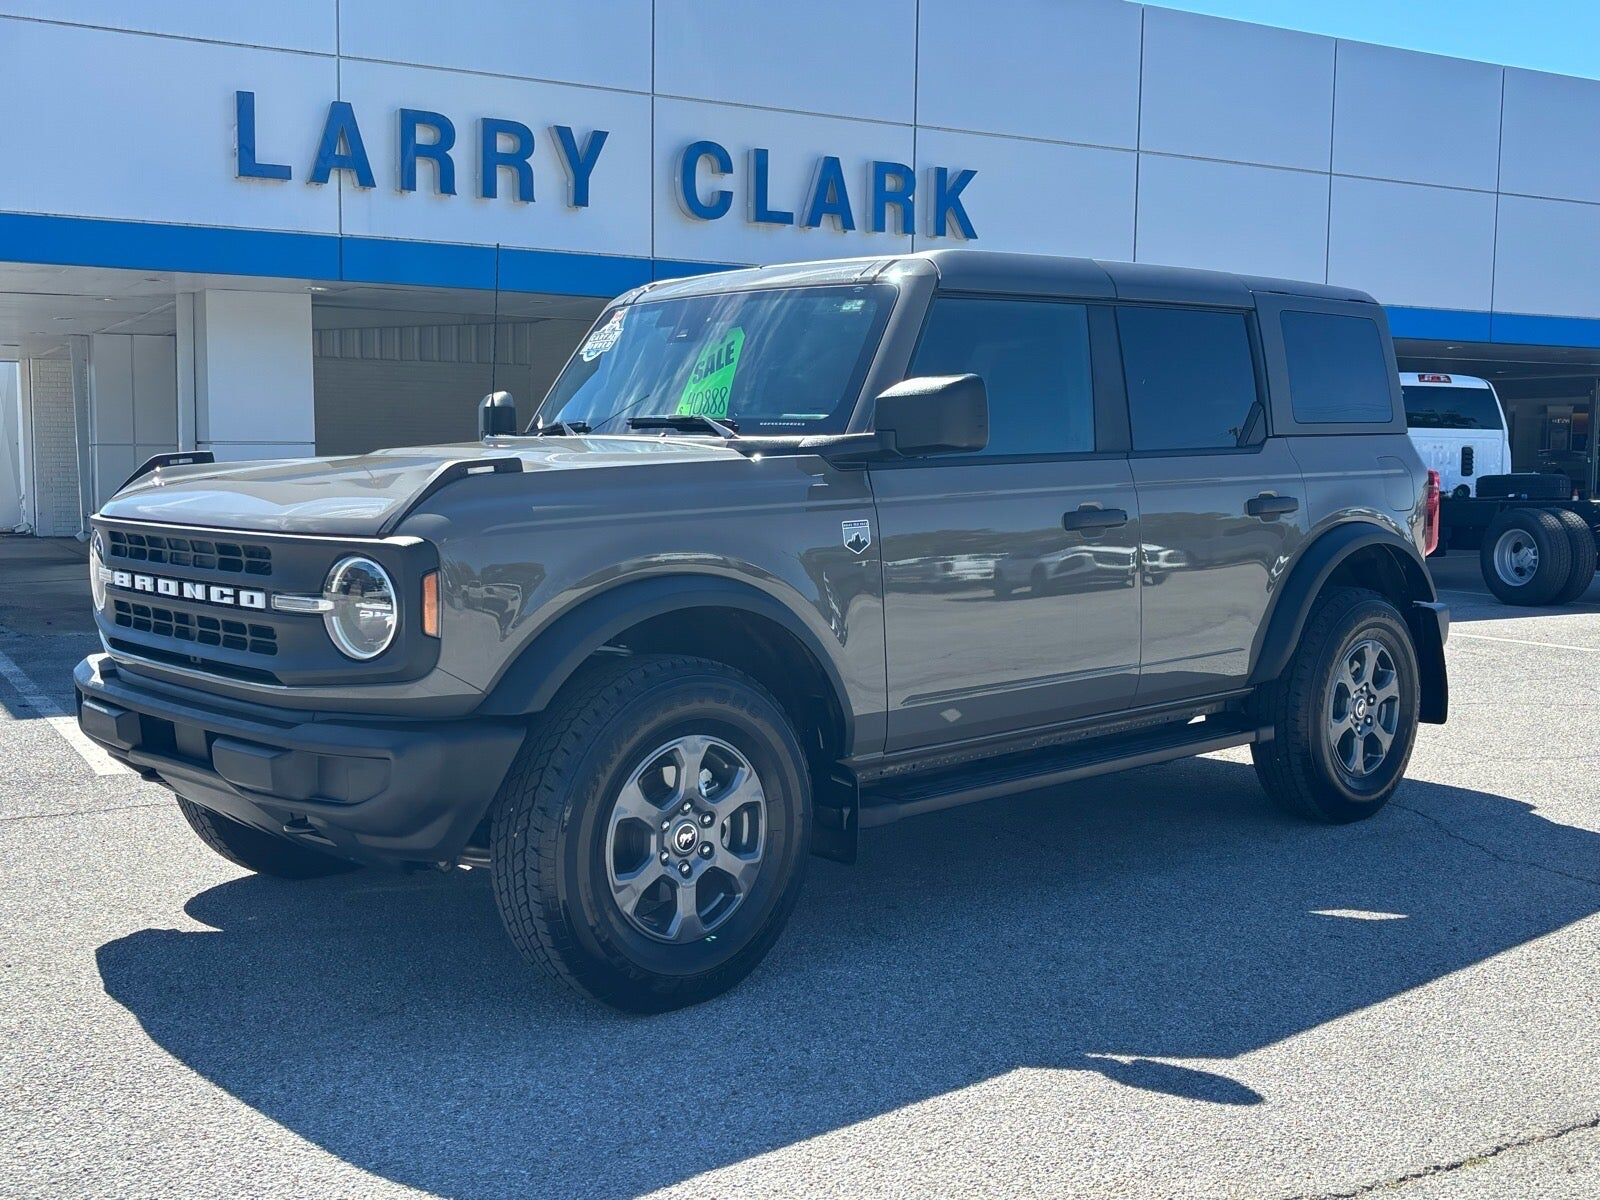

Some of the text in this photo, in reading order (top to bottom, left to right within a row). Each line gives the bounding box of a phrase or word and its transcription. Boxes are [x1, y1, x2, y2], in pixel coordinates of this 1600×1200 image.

[234, 91, 978, 240] LARRY CLARK
[692, 340, 735, 385] SALE
[114, 571, 266, 609] BRONCO
